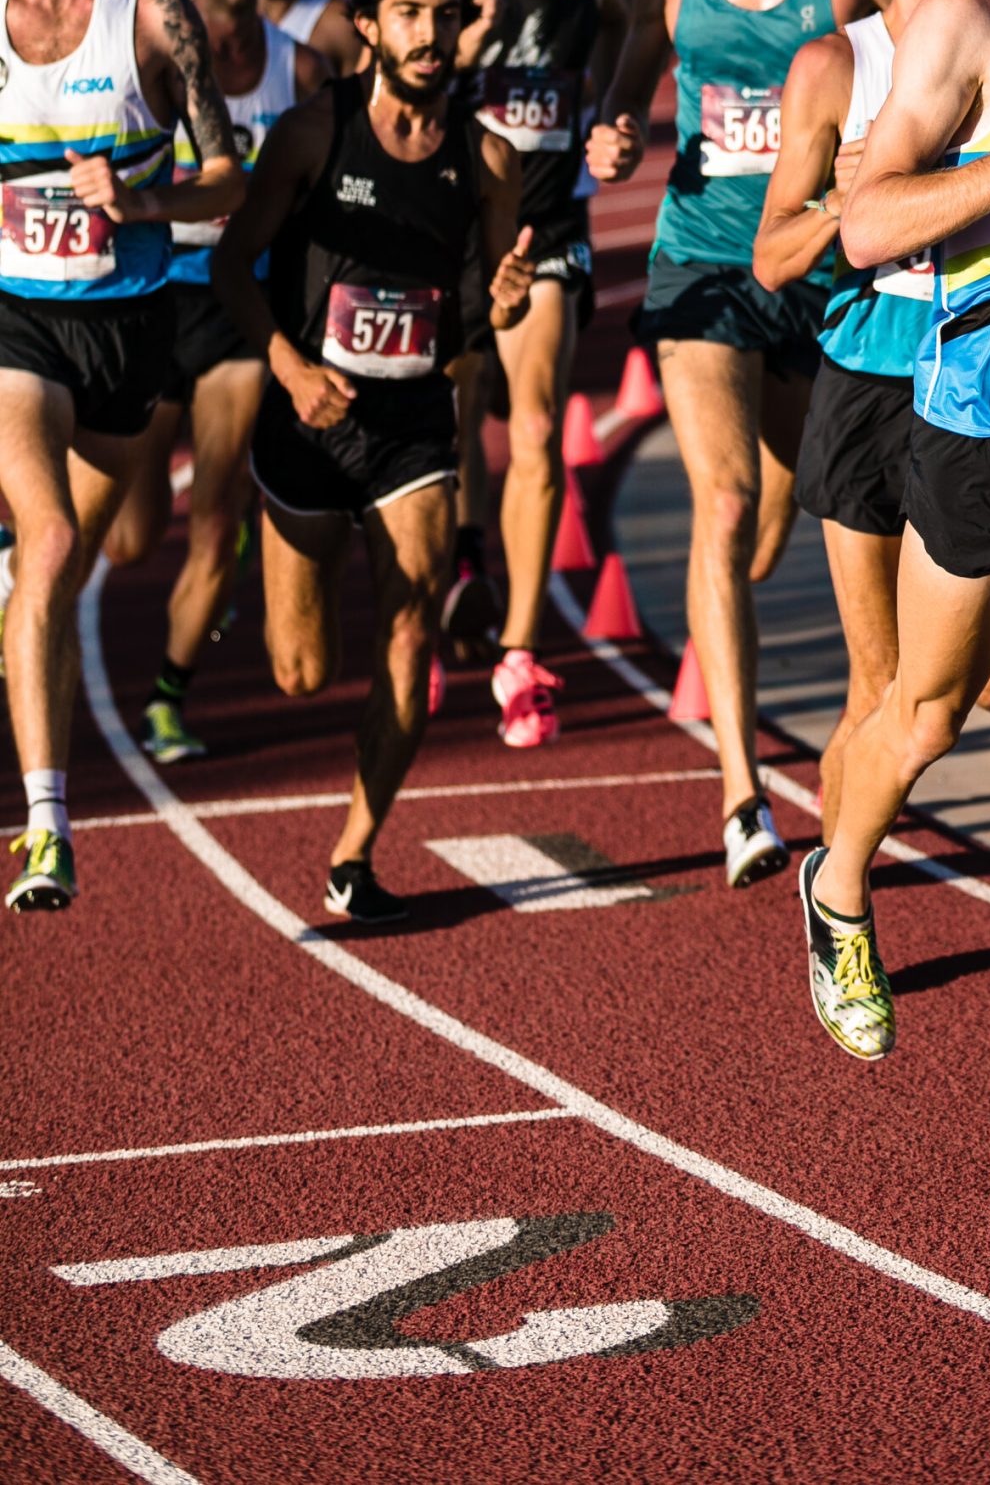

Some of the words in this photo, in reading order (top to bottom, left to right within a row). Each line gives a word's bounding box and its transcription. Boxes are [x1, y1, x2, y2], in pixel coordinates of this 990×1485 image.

[63, 76, 114, 95] HOKA
[505, 90, 560, 127] 563
[724, 107, 781, 151] 568
[24, 209, 90, 253] 573
[351, 309, 413, 353] 571
[51, 1215, 669, 1379] 2
